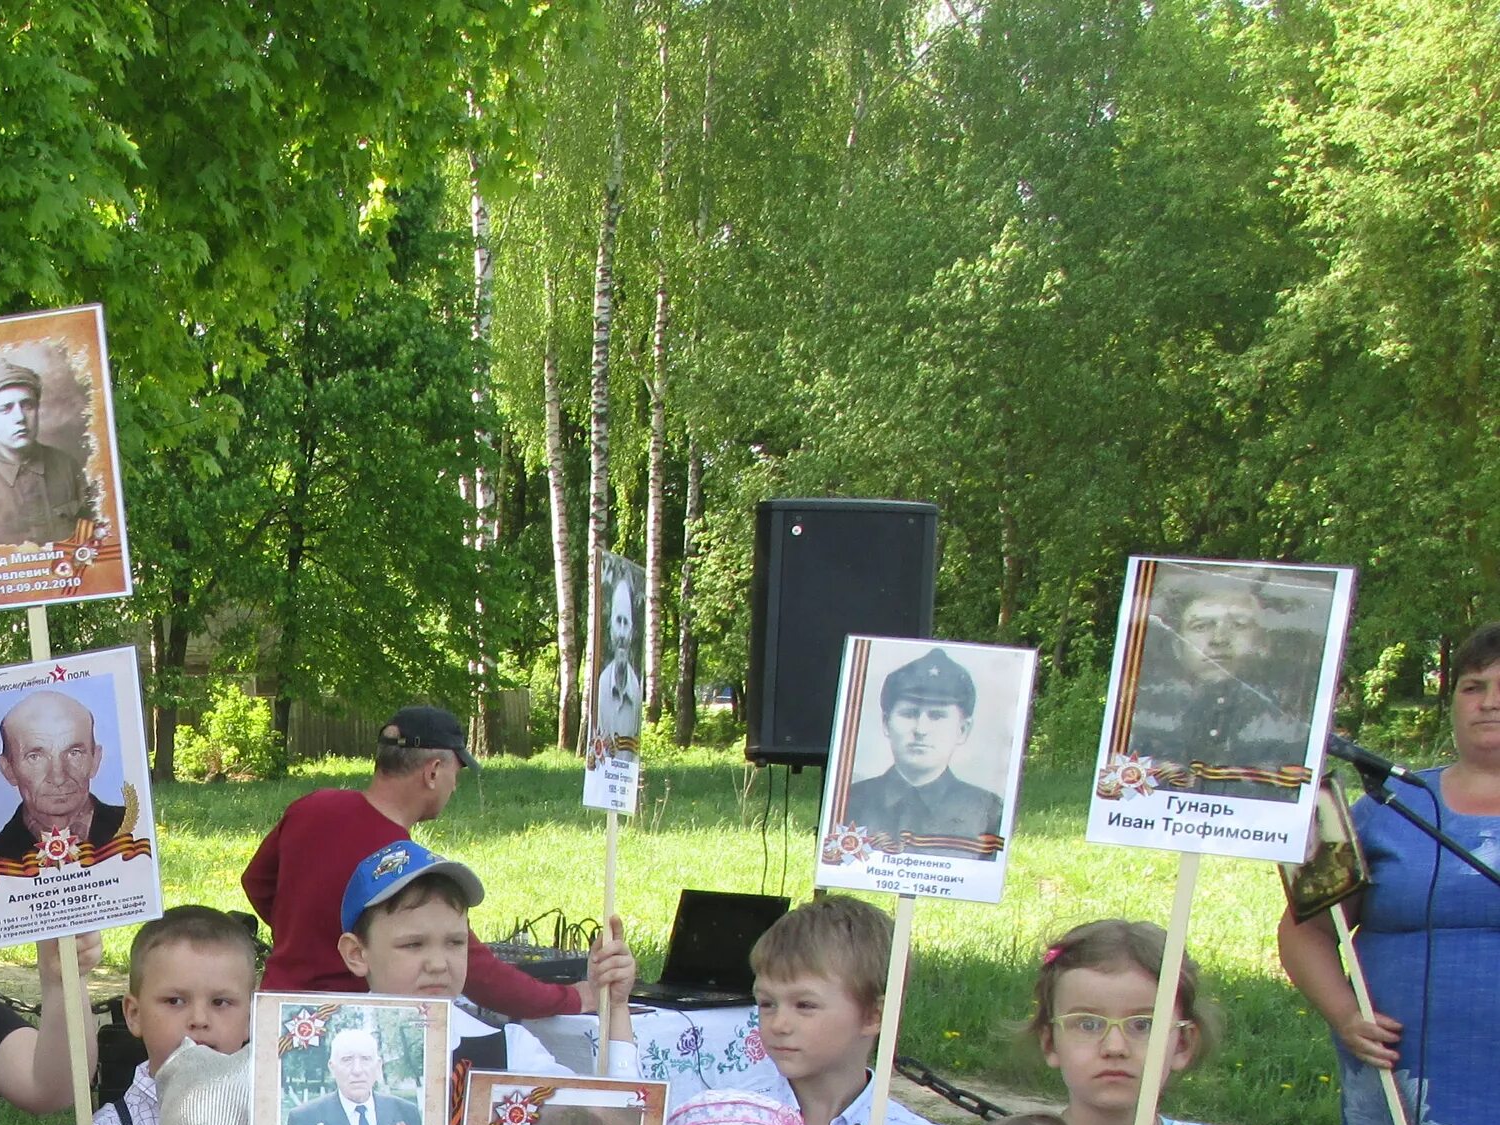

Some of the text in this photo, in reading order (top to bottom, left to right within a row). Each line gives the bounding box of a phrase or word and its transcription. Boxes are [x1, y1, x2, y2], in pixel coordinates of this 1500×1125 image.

[10, 550, 64, 564] Михаил
[1166, 796, 1234, 816] Гунарь
[1107, 812, 1288, 844] Иван Трофимович
[882, 854, 951, 869] Парфененко
[34, 869, 91, 886] Потоцкий
[866, 865, 964, 883] Иван Степанович
[8, 877, 119, 903] Алексей иванович
[876, 880, 900, 890] 1902
[913, 883, 937, 894] 1945
[29, 892, 102, 912] 1920-1998гг.
